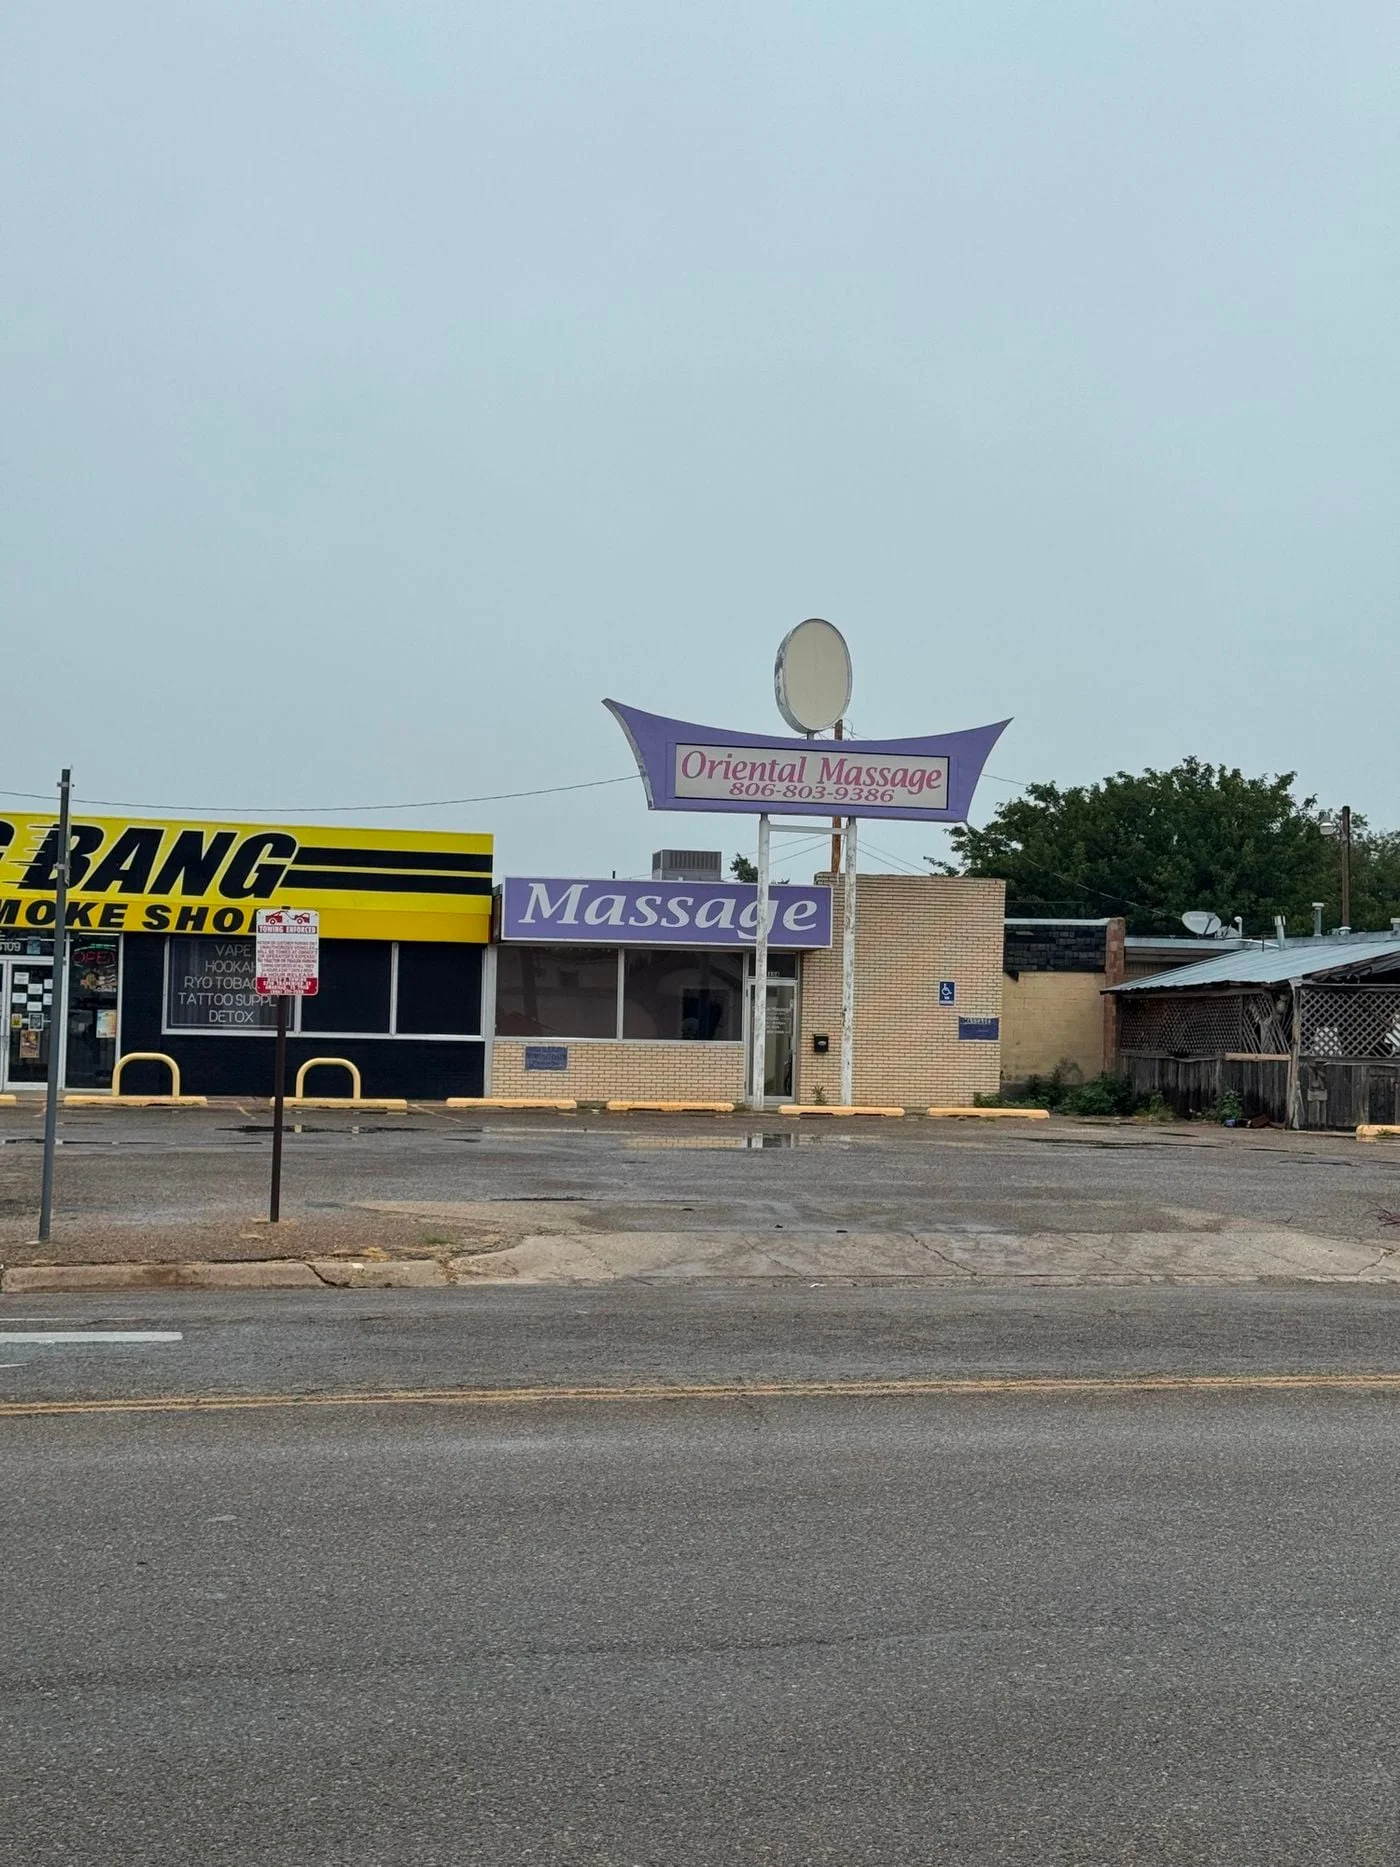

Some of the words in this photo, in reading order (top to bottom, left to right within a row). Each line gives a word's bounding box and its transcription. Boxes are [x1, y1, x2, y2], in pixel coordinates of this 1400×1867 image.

[681, 750, 807, 784] Oriental
[818, 757, 943, 795] Massage
[729, 782, 895, 803] 806-803-9386
[17, 823, 297, 899] BANG
[518, 883, 818, 940] Massage
[285, 926, 316, 934] ENFORCED
[215, 944, 252, 957] VAPE
[205, 960, 256, 973] HOOKAH
[184, 976, 212, 989] RYO
[178, 992, 233, 1006] TATTOO
[236, 993, 280, 1007] SUPPL
[209, 1010, 254, 1023] DETOX
